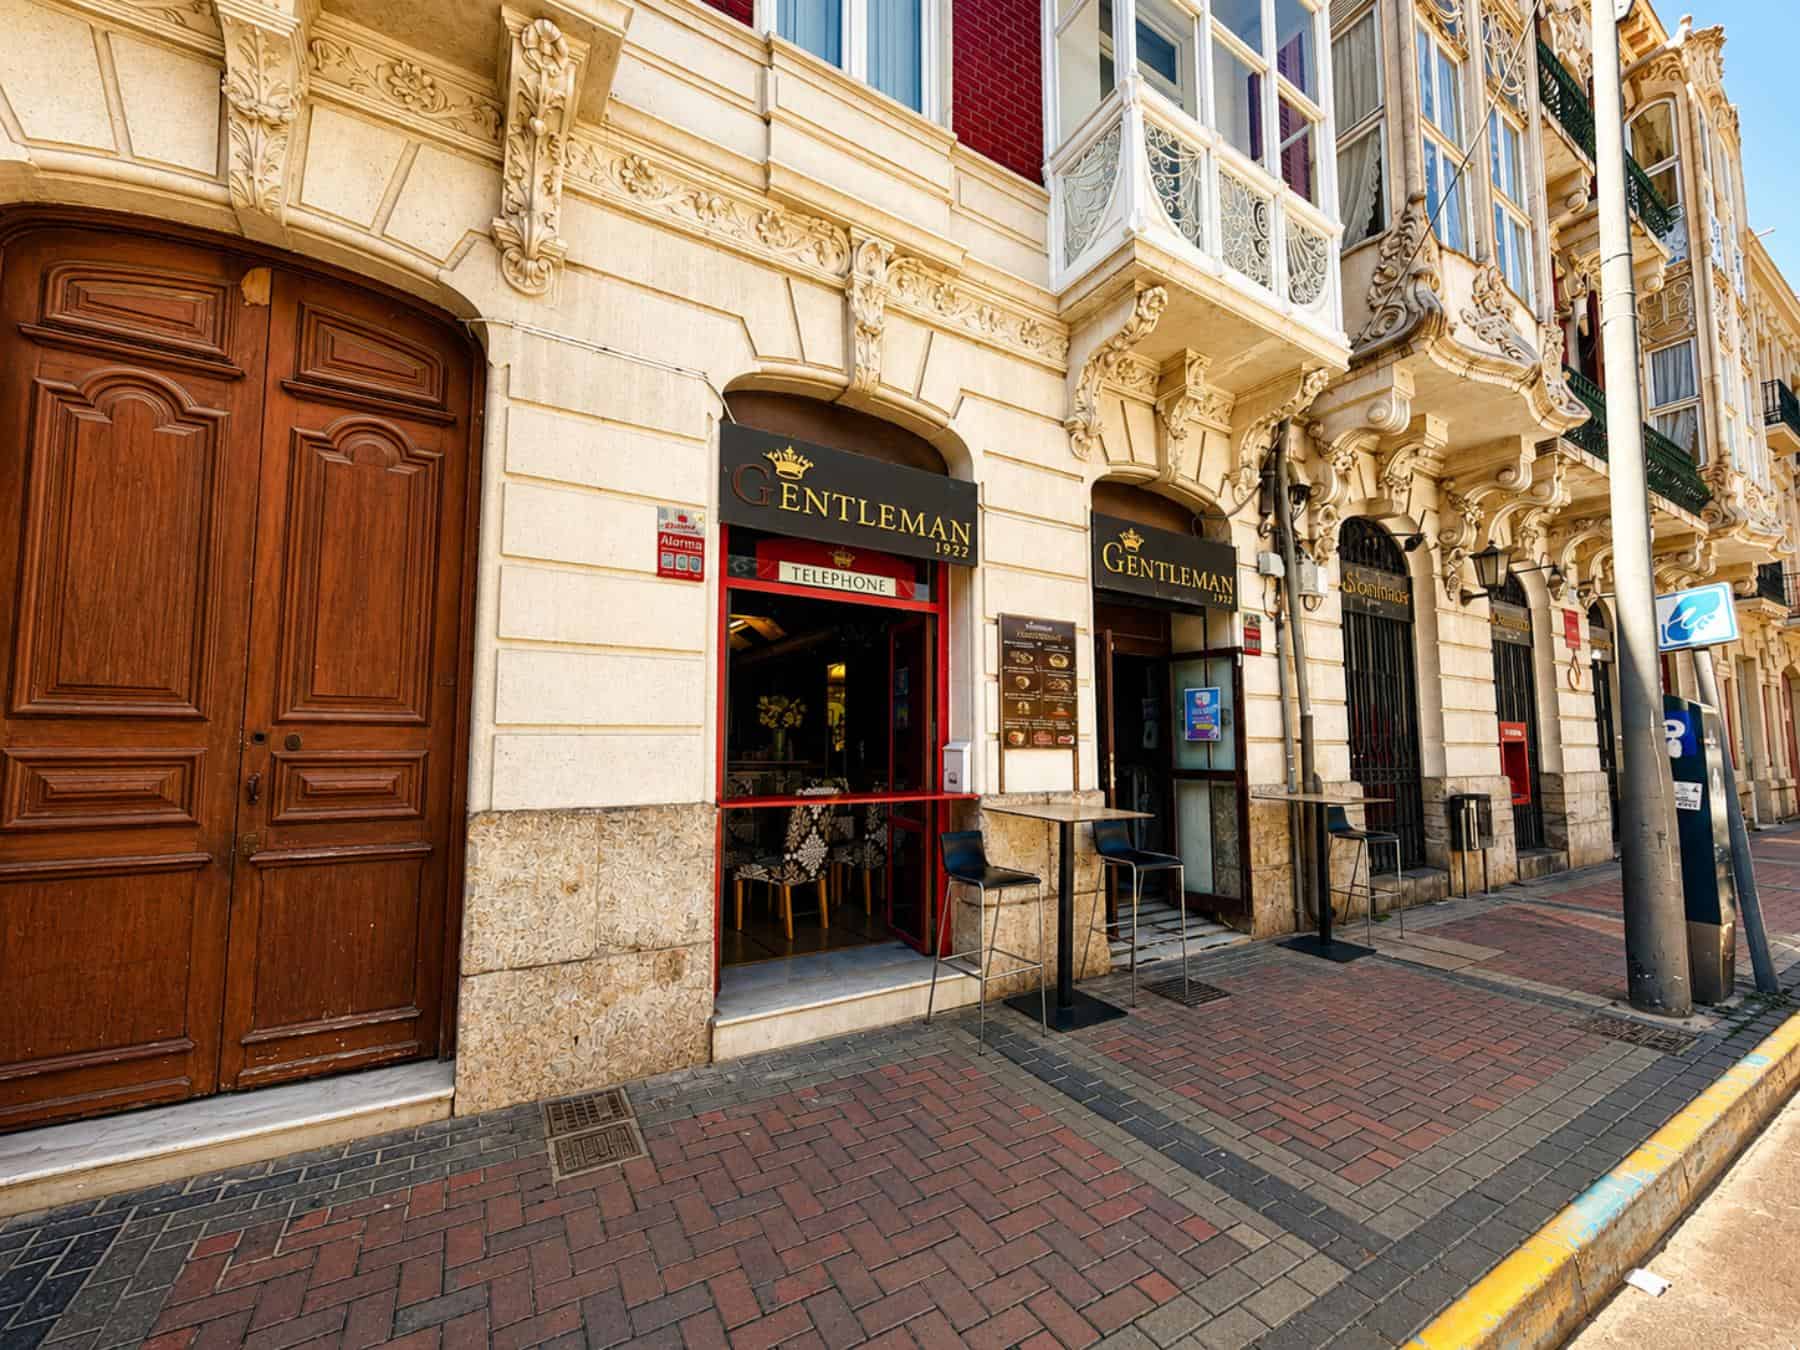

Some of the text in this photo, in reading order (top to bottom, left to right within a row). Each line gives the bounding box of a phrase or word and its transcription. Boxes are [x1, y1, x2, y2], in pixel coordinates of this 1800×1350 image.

[732, 464, 971, 546] GENTLEMAN
[662, 534, 702, 551] Alarma
[935, 541, 969, 558] 1922
[791, 566, 886, 593] TELEPHONE
[1102, 542, 1233, 593] GENTLEMAN
